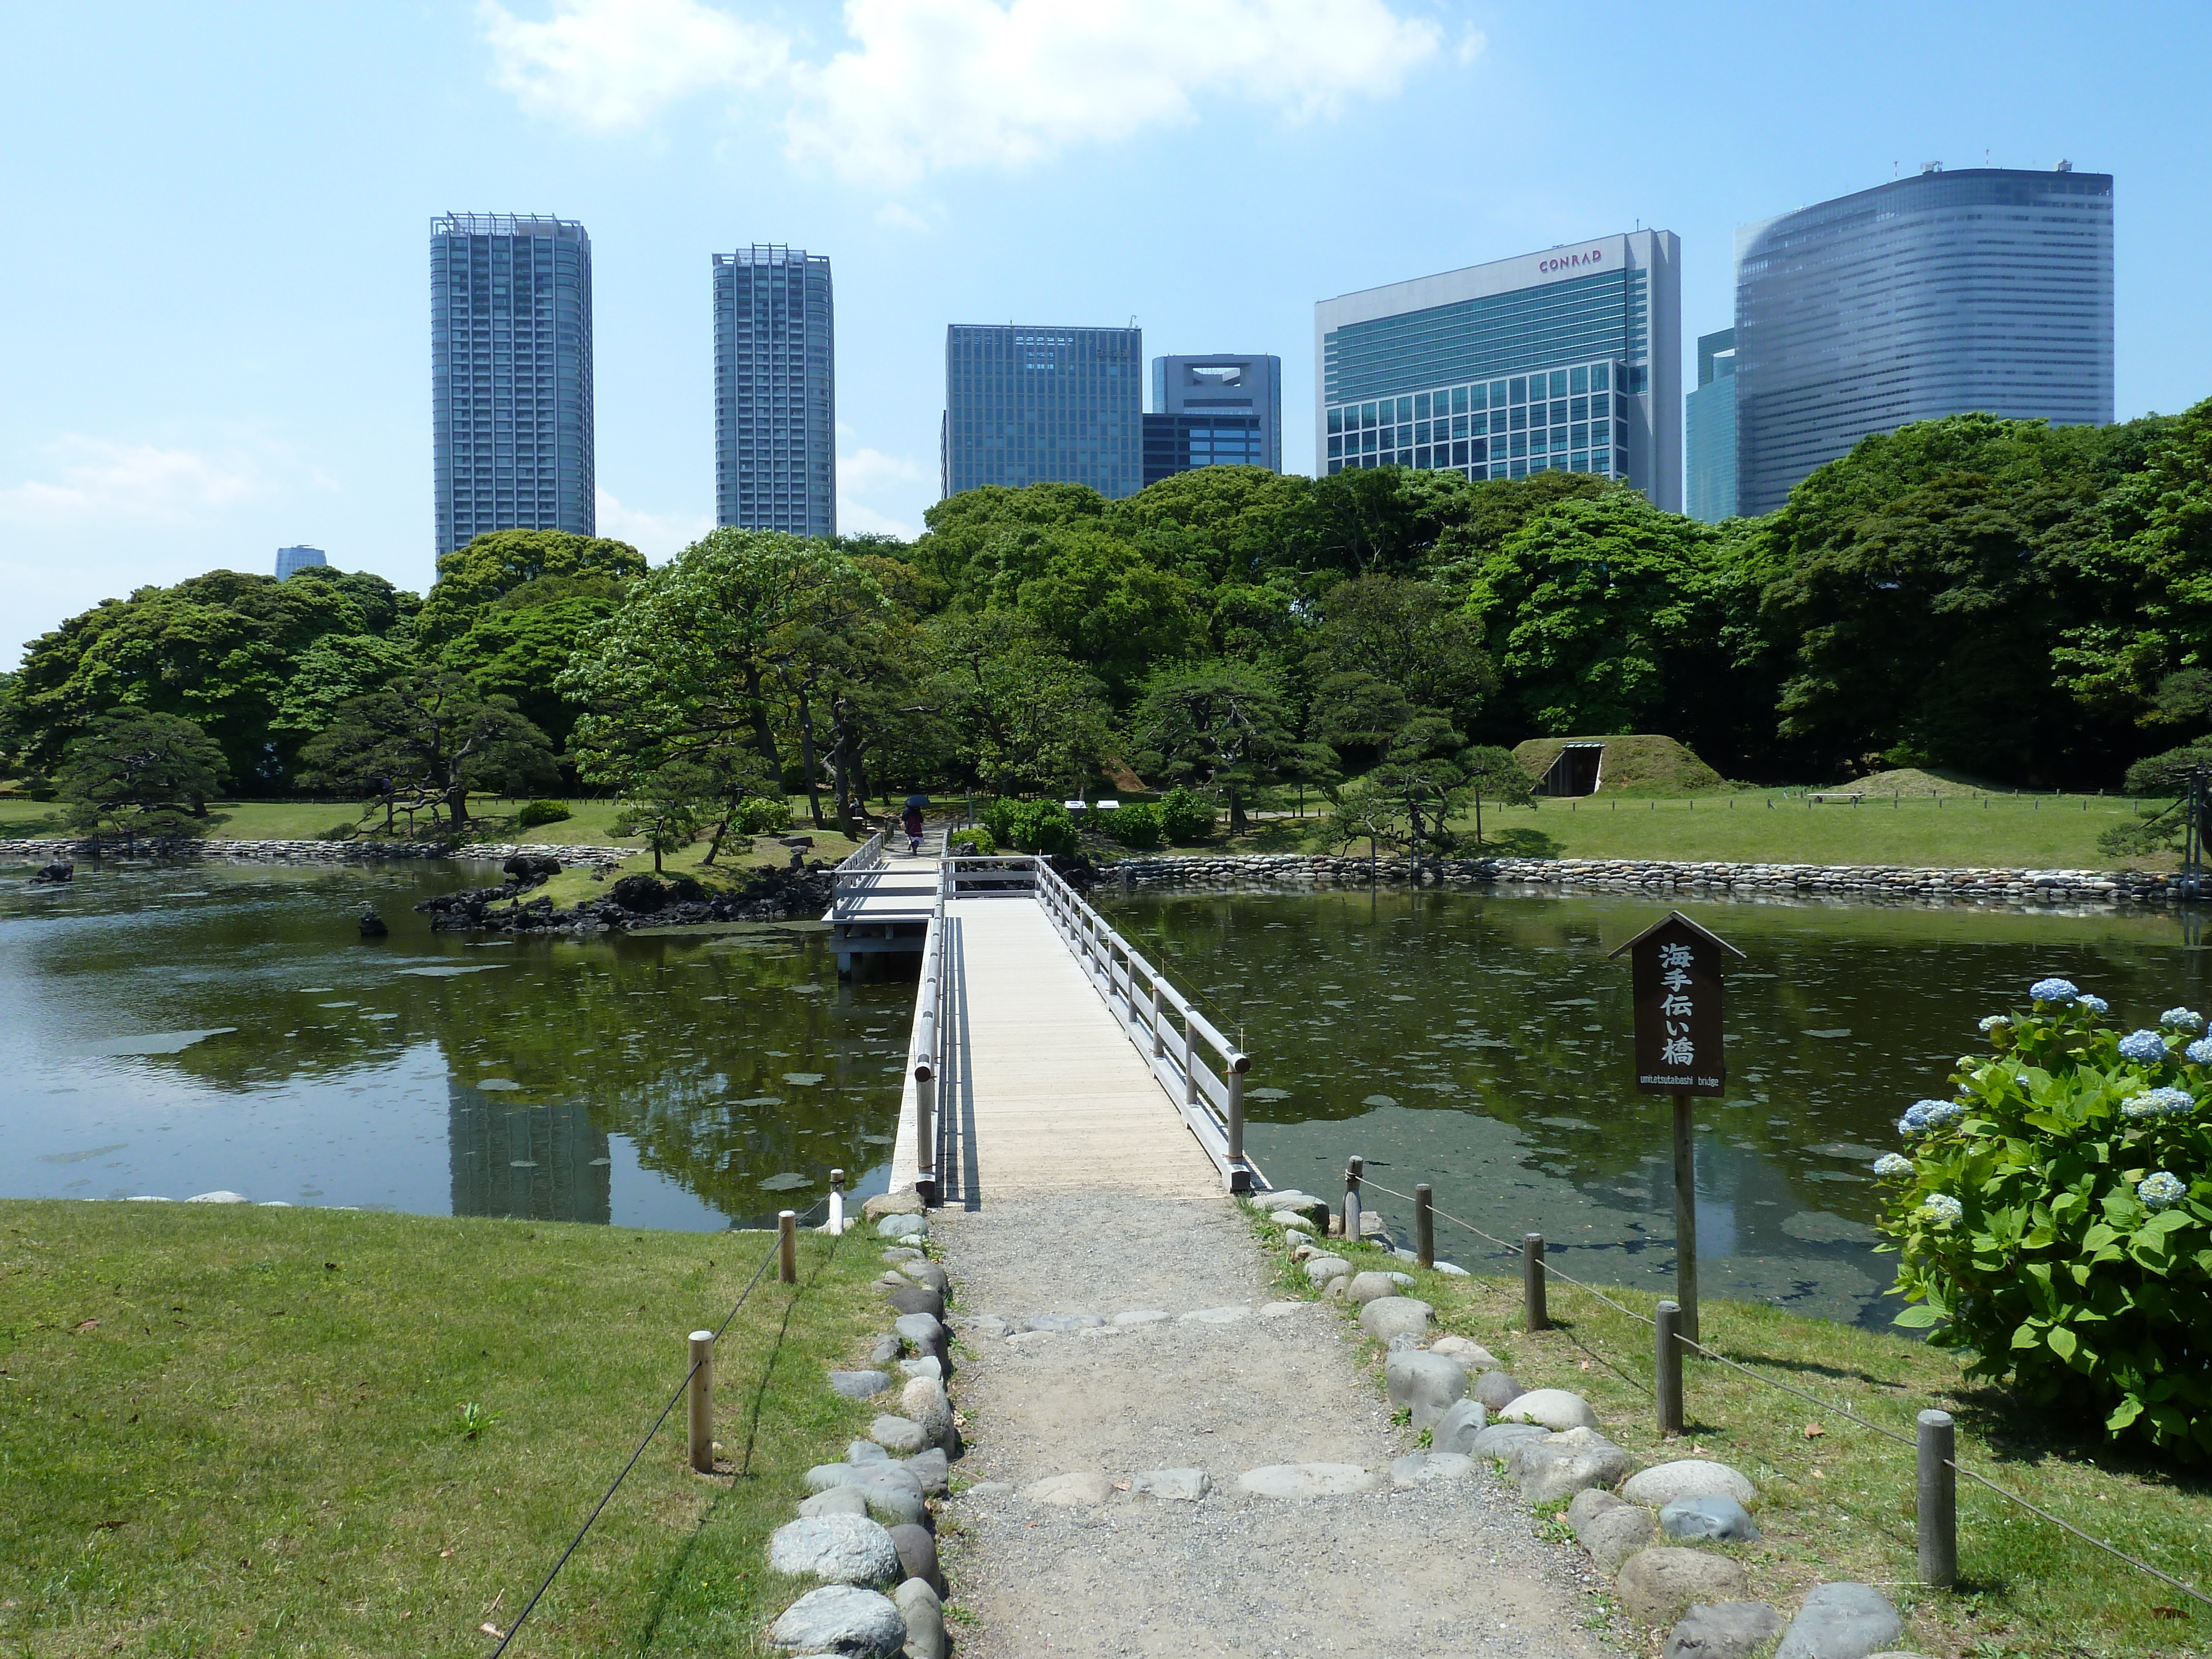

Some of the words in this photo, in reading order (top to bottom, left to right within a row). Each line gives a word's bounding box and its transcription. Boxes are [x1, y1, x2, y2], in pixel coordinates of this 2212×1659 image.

[1539, 250, 1601, 272] CONRAD
[1658, 943, 1695, 1066] 海手伝い橋
[1698, 1076, 1719, 1087] bridge
